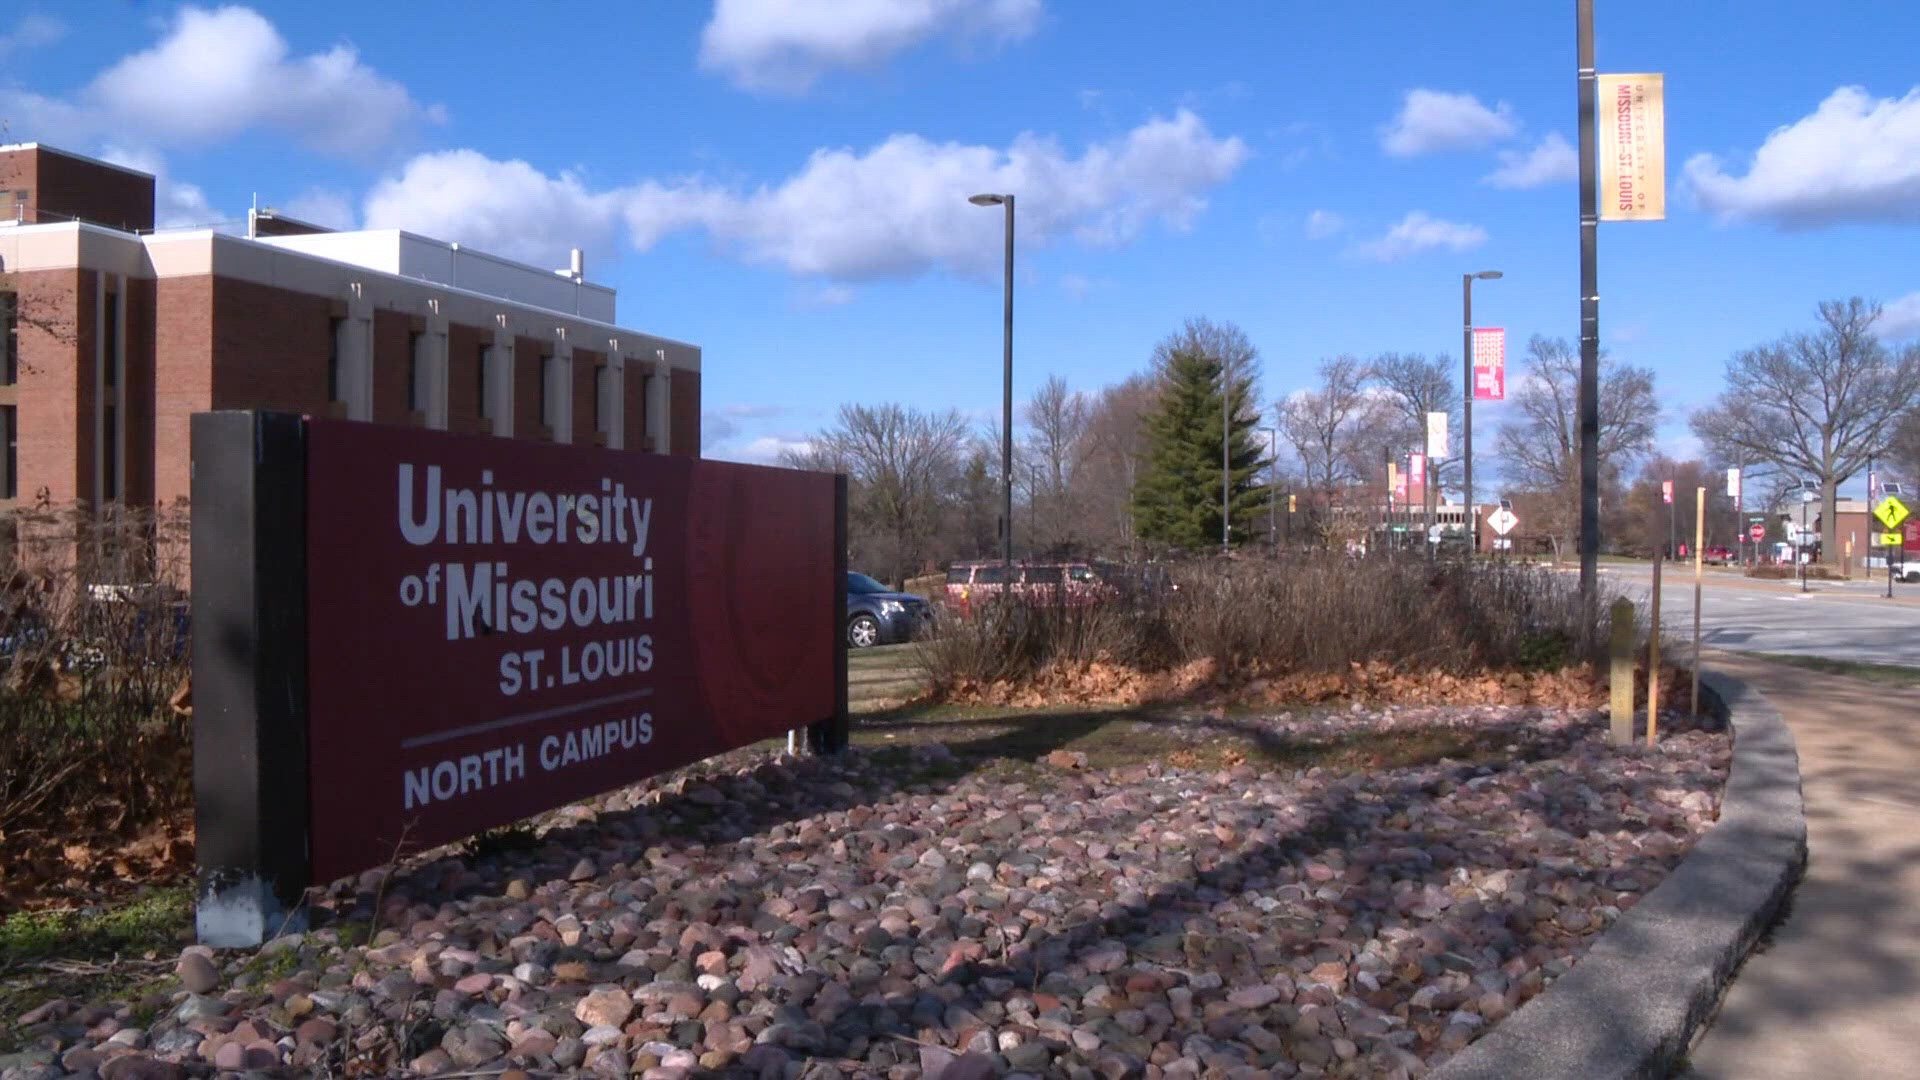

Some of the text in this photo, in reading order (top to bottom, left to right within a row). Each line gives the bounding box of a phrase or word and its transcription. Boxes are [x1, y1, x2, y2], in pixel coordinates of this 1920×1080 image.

[1619, 175, 1633, 212] LOUIS
[1637, 192, 1646, 210] OF
[1473, 355, 1503, 367] MORE
[399, 463, 652, 556] University
[400, 557, 653, 640] of Missouri
[562, 634, 653, 685] LOUIS
[404, 712, 653, 809] NORTH CAMPUS
